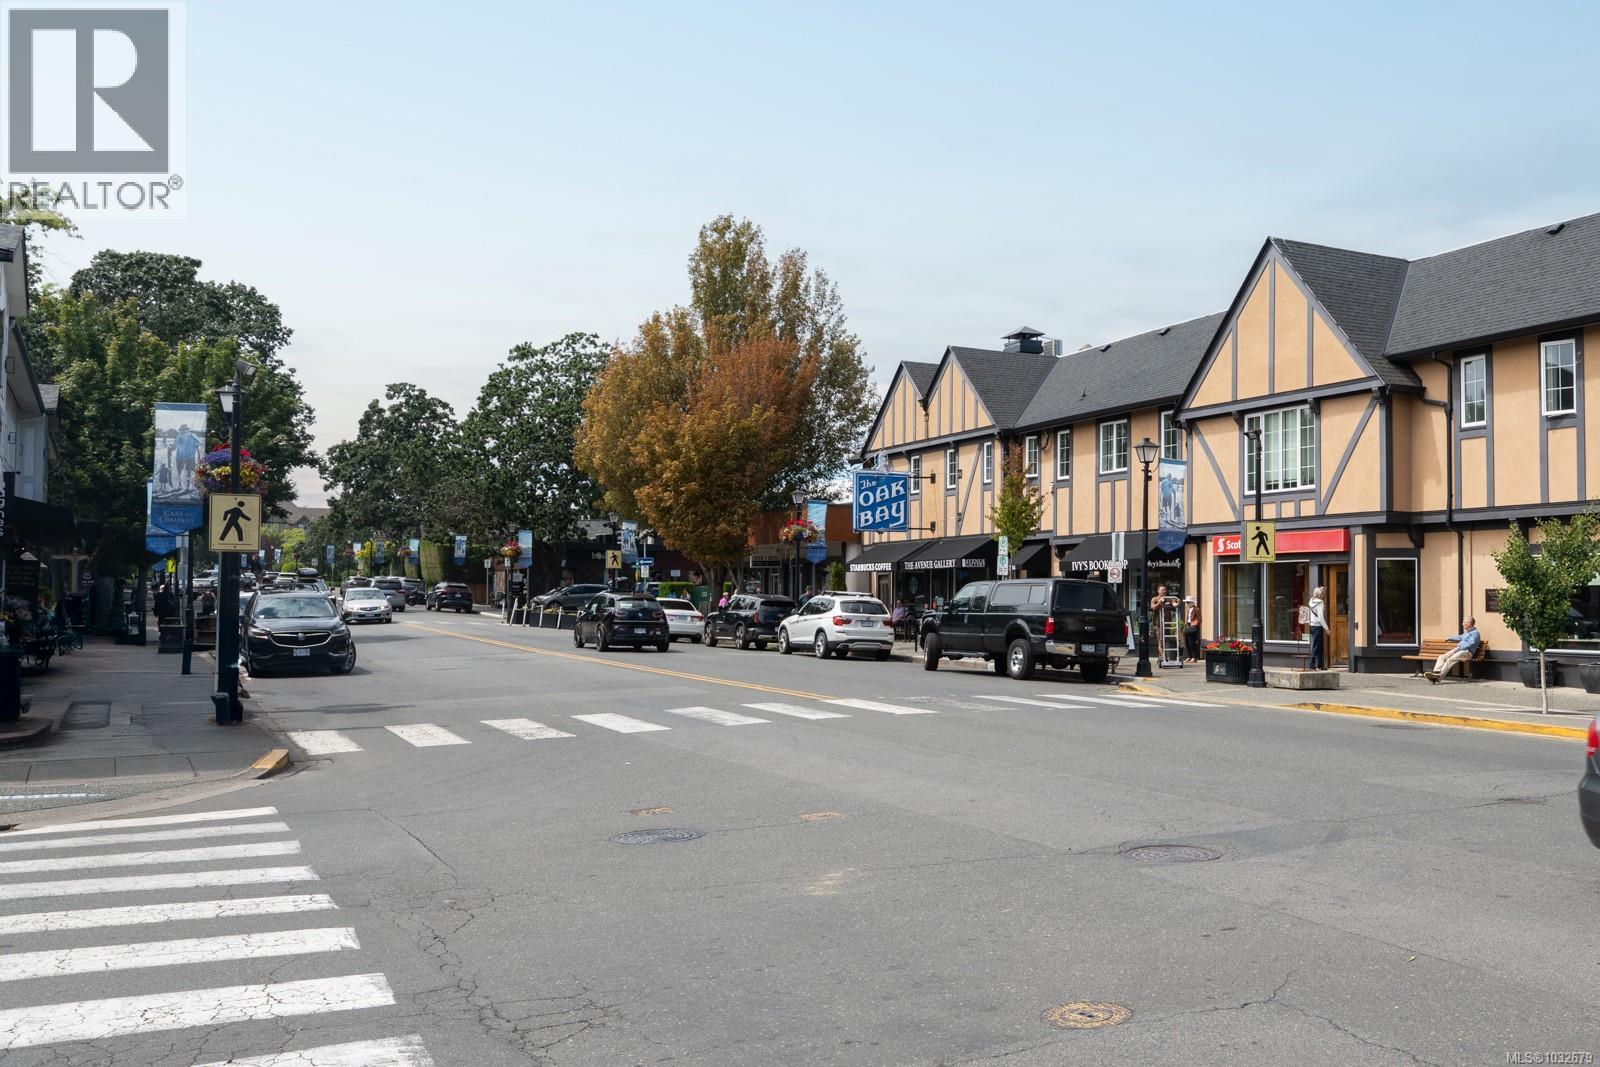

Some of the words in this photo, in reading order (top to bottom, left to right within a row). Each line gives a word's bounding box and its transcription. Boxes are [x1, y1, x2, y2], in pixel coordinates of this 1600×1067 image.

[860, 480, 877, 489] The
[859, 480, 906, 507] OAK
[858, 500, 906, 528] BAY
[1226, 540, 1241, 550] Scot
[850, 563, 875, 572] STARBUCKS
[875, 562, 892, 571] COFFEE
[904, 561, 914, 570] THE
[914, 560, 934, 570] AVENUE
[933, 558, 956, 569] GALLERY
[1071, 560, 1089, 571] IVY'S
